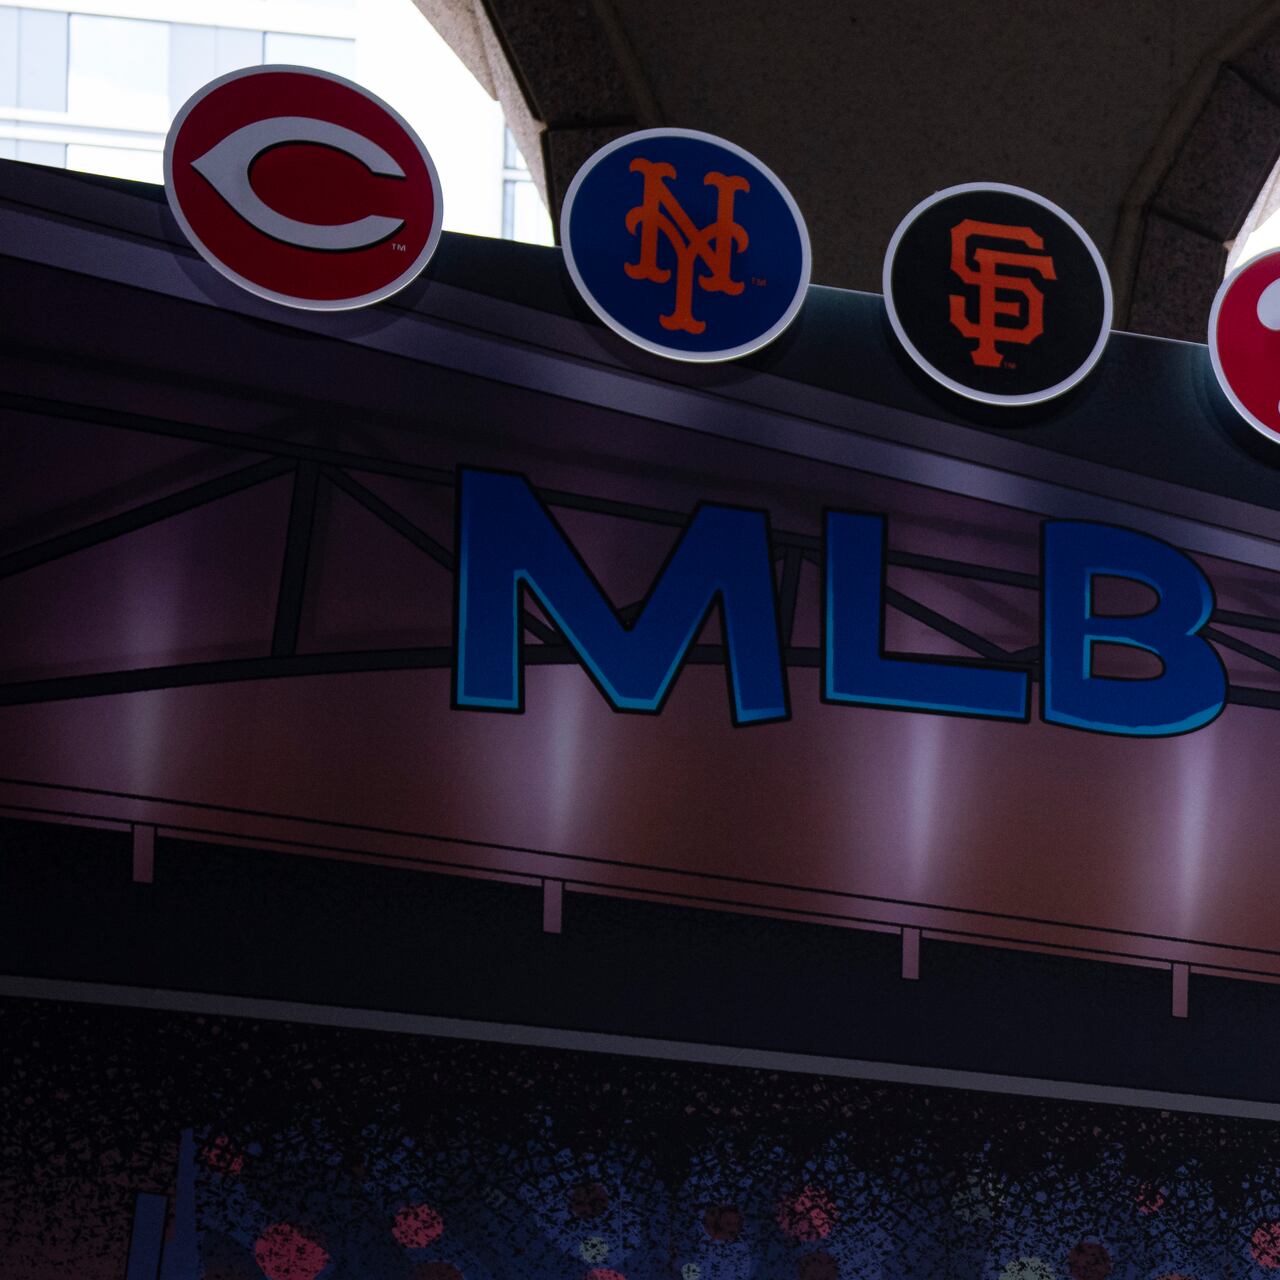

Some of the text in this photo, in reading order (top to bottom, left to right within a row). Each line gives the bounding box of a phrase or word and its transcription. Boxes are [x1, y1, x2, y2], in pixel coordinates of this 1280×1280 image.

[190, 115, 407, 252] C
[949, 218, 1058, 368] SF
[453, 467, 1229, 737] MLB
